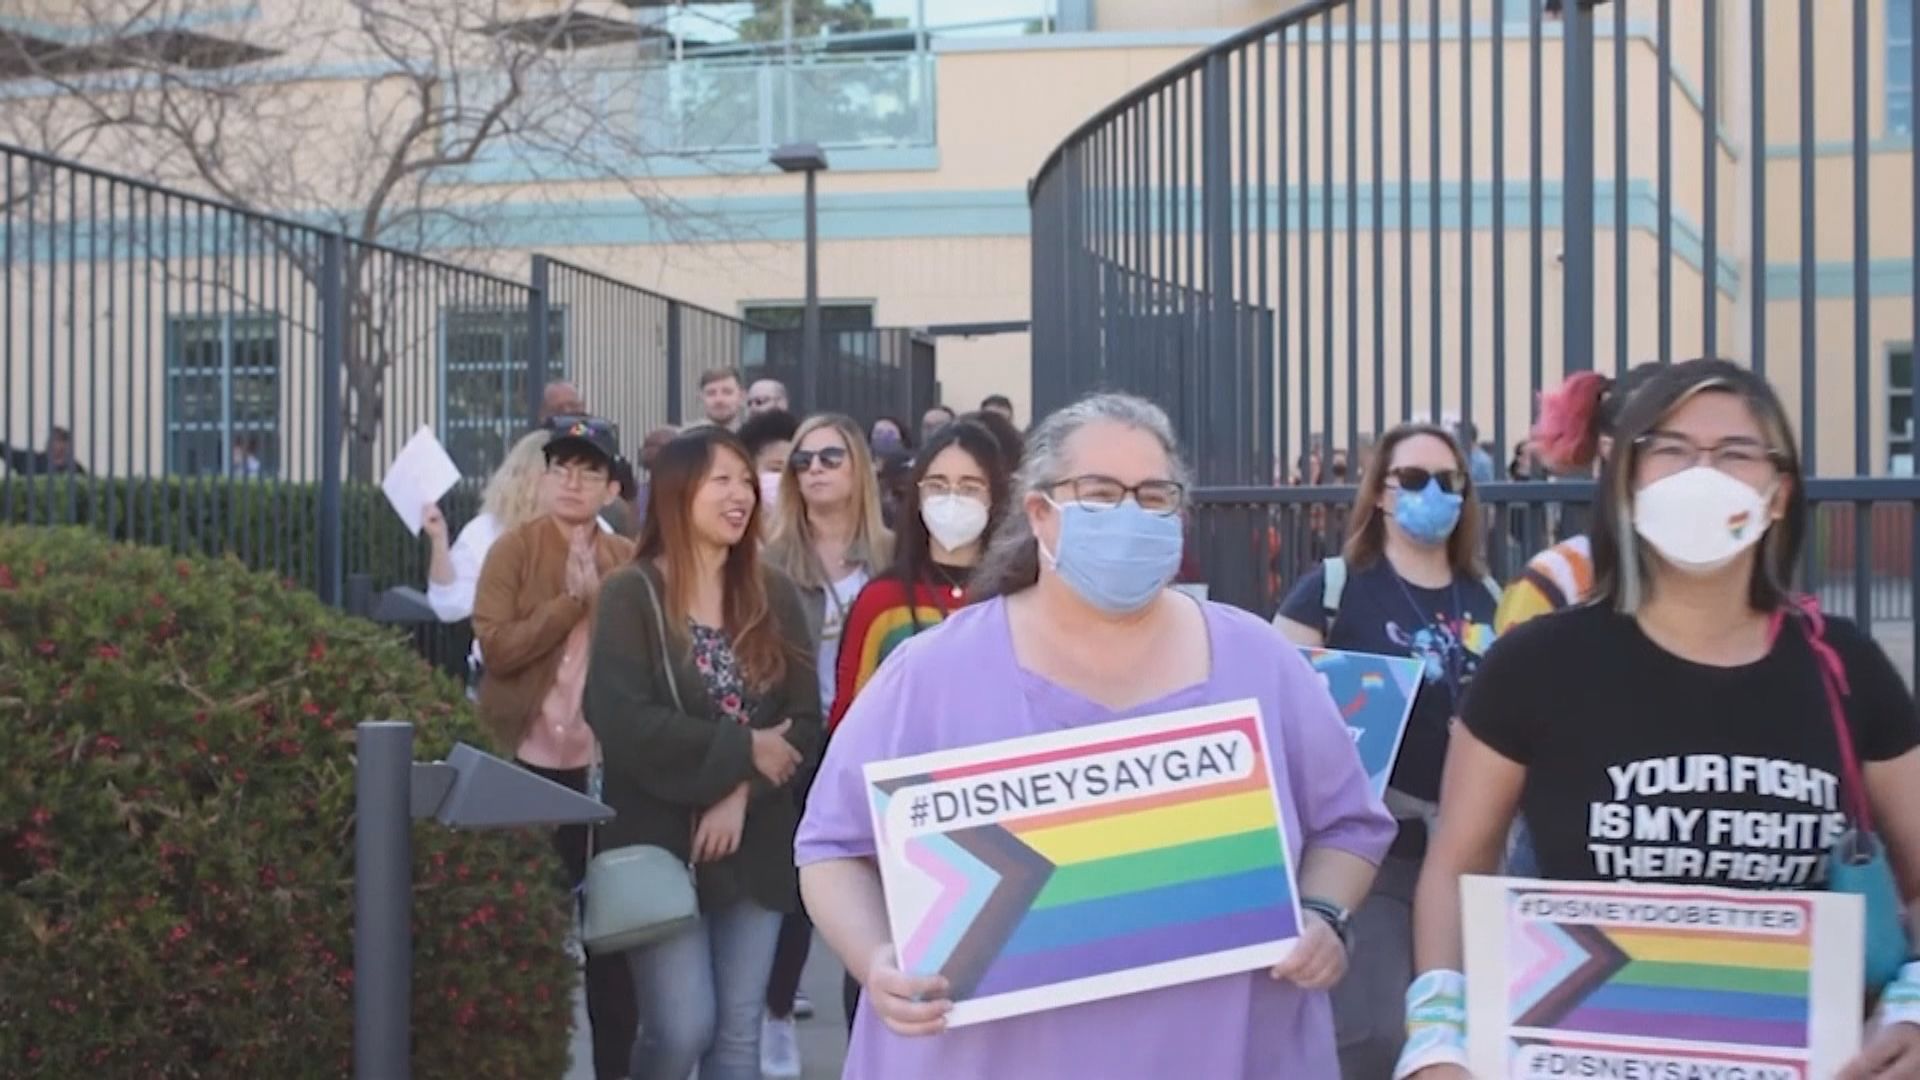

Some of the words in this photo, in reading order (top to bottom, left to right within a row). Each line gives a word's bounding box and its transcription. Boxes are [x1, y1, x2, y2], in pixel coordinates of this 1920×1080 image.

[909, 740, 1240, 827] #DISNEYSAYGAY
[1606, 754, 1729, 801] YOUR
[1730, 756, 1840, 811] FIGHT
[1588, 802, 1631, 839] IS
[1633, 805, 1704, 842] MY
[1707, 810, 1820, 849] FIGHT
[1587, 843, 1704, 878] THEIR
[1704, 850, 1818, 883] FIGHT
[1519, 899, 1799, 929] #DISNEYDOBETTER
